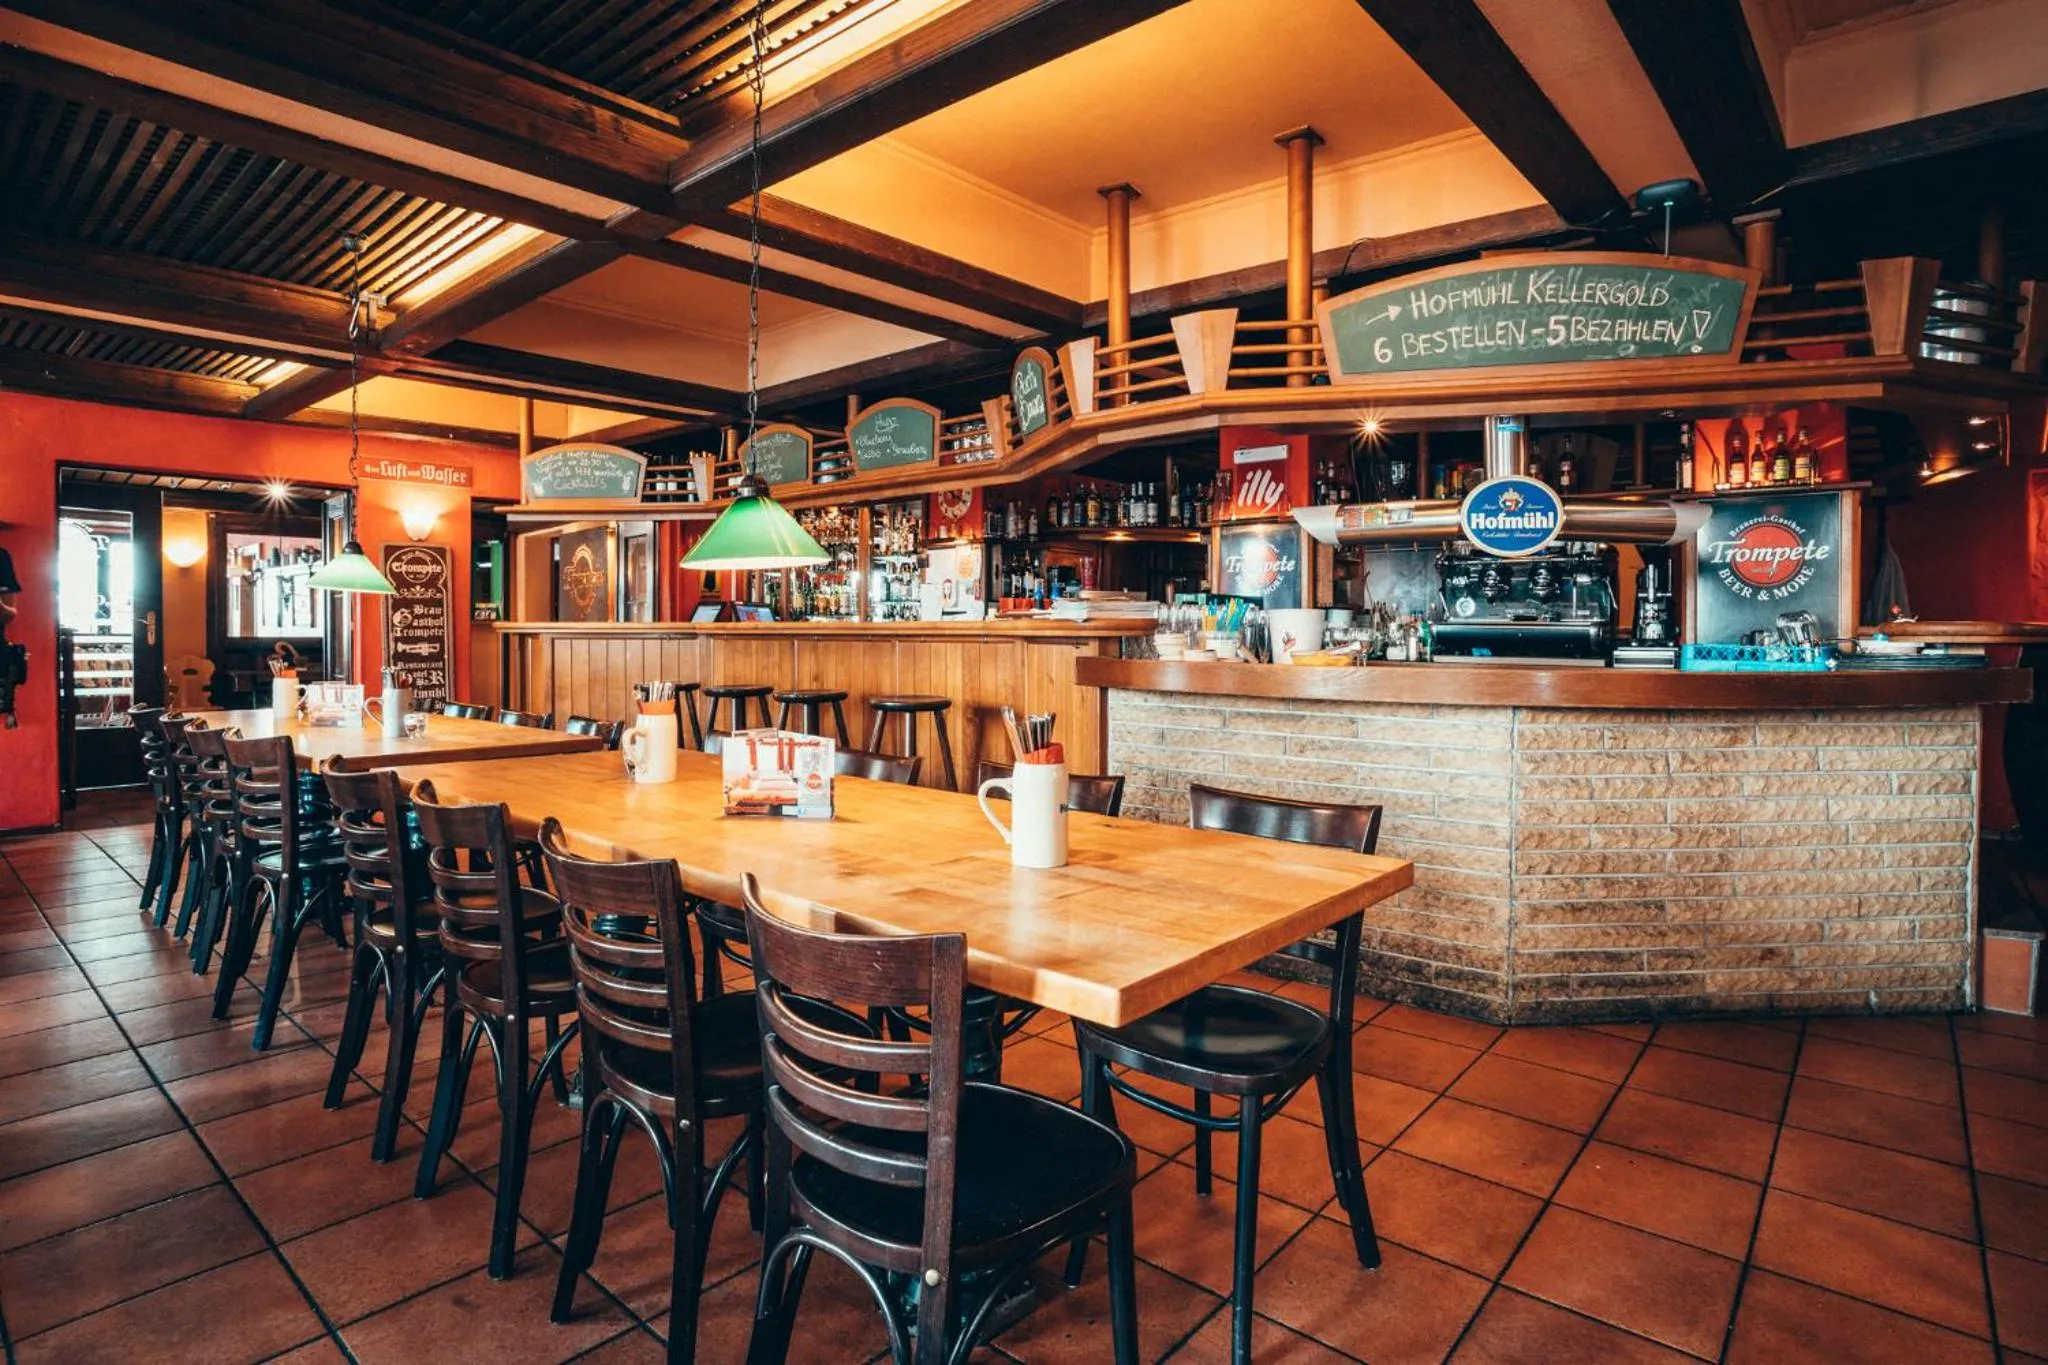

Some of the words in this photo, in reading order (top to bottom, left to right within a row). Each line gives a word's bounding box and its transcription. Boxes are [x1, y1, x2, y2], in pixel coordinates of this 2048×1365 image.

[1410, 280, 1519, 320] HOFMÜHL
[1526, 270, 1670, 307] KELLERGOLD
[1373, 336, 1394, 363] 6
[1401, 318, 1526, 359] BESTELLEN
[1237, 469, 1285, 514] illy
[1470, 511, 1554, 529] Hofmühl
[1708, 538, 1830, 581] Trompete
[1718, 568, 1753, 598] BEER
[1757, 589, 1770, 601] &
[1772, 566, 1815, 599] MORE
